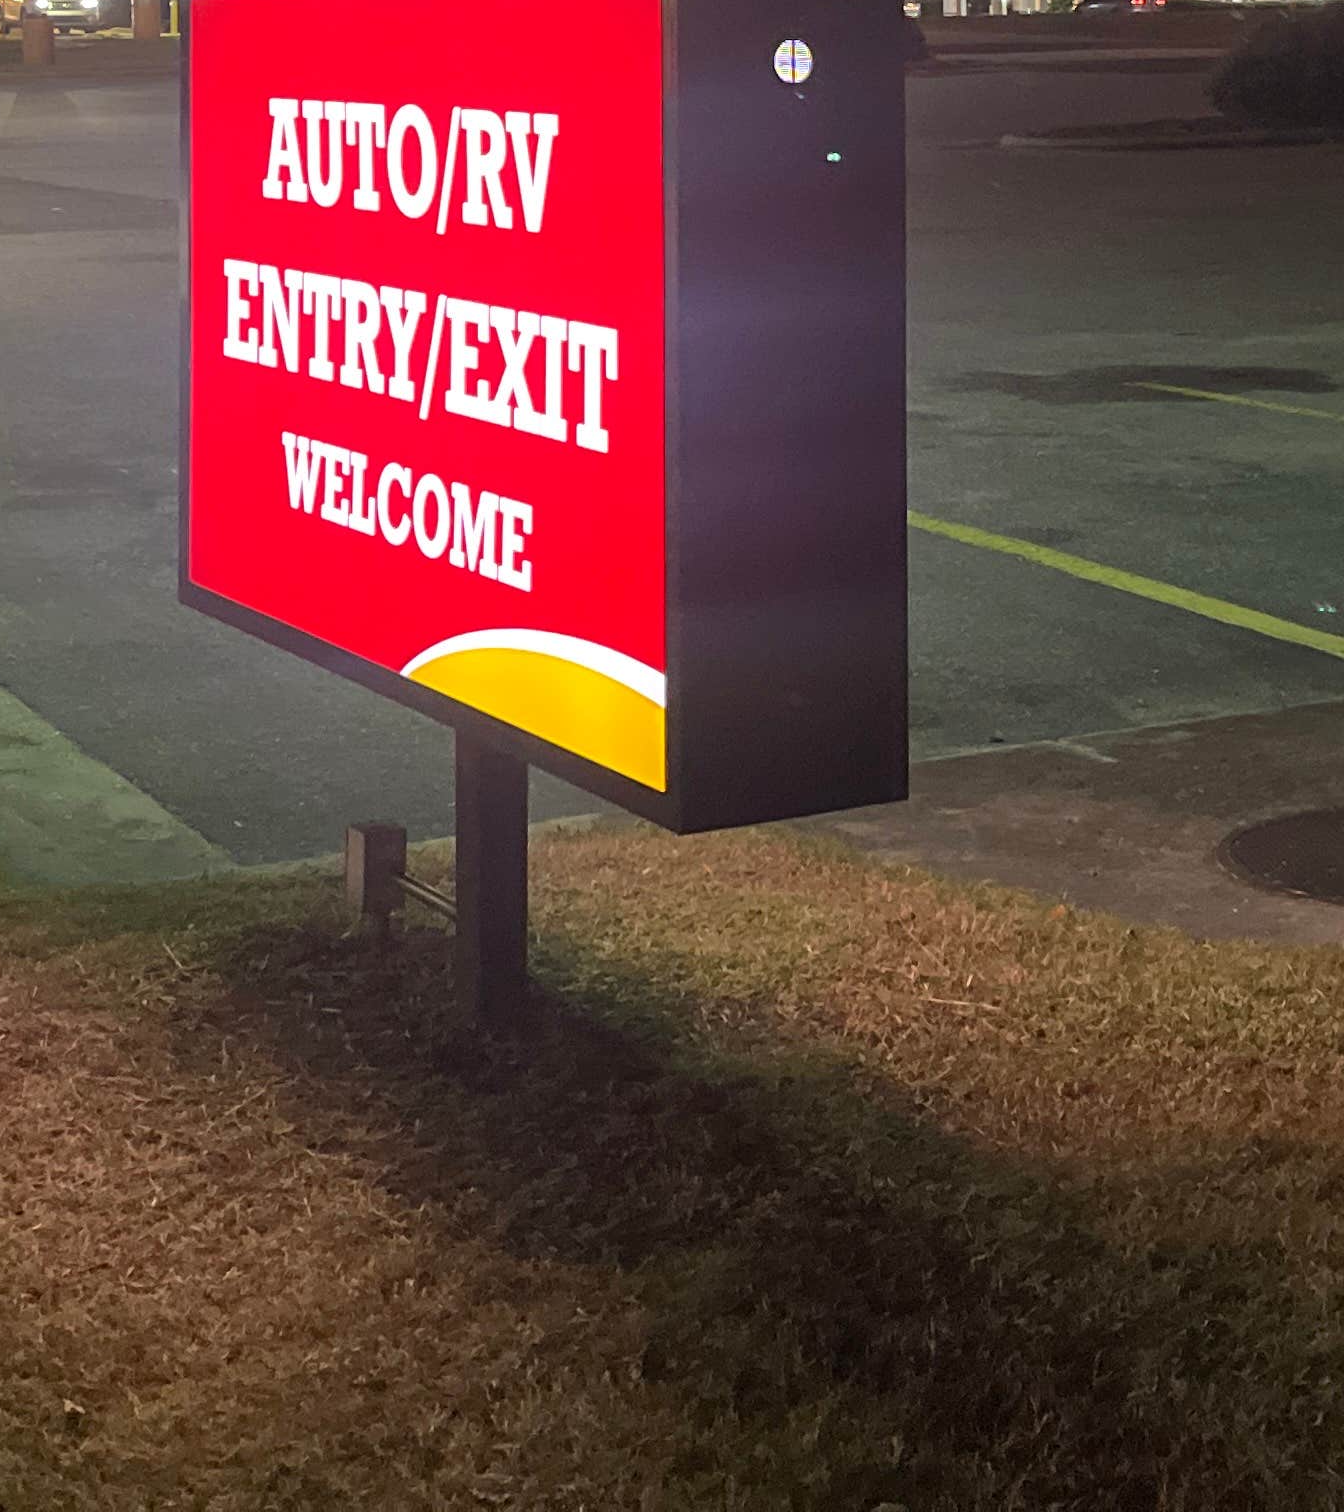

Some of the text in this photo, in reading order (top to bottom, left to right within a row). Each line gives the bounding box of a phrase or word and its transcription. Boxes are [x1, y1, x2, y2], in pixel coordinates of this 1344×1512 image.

[262, 97, 560, 235] AUTO/RV
[223, 259, 619, 453] ENTRY/EXIT
[282, 432, 534, 592] WELCOME
